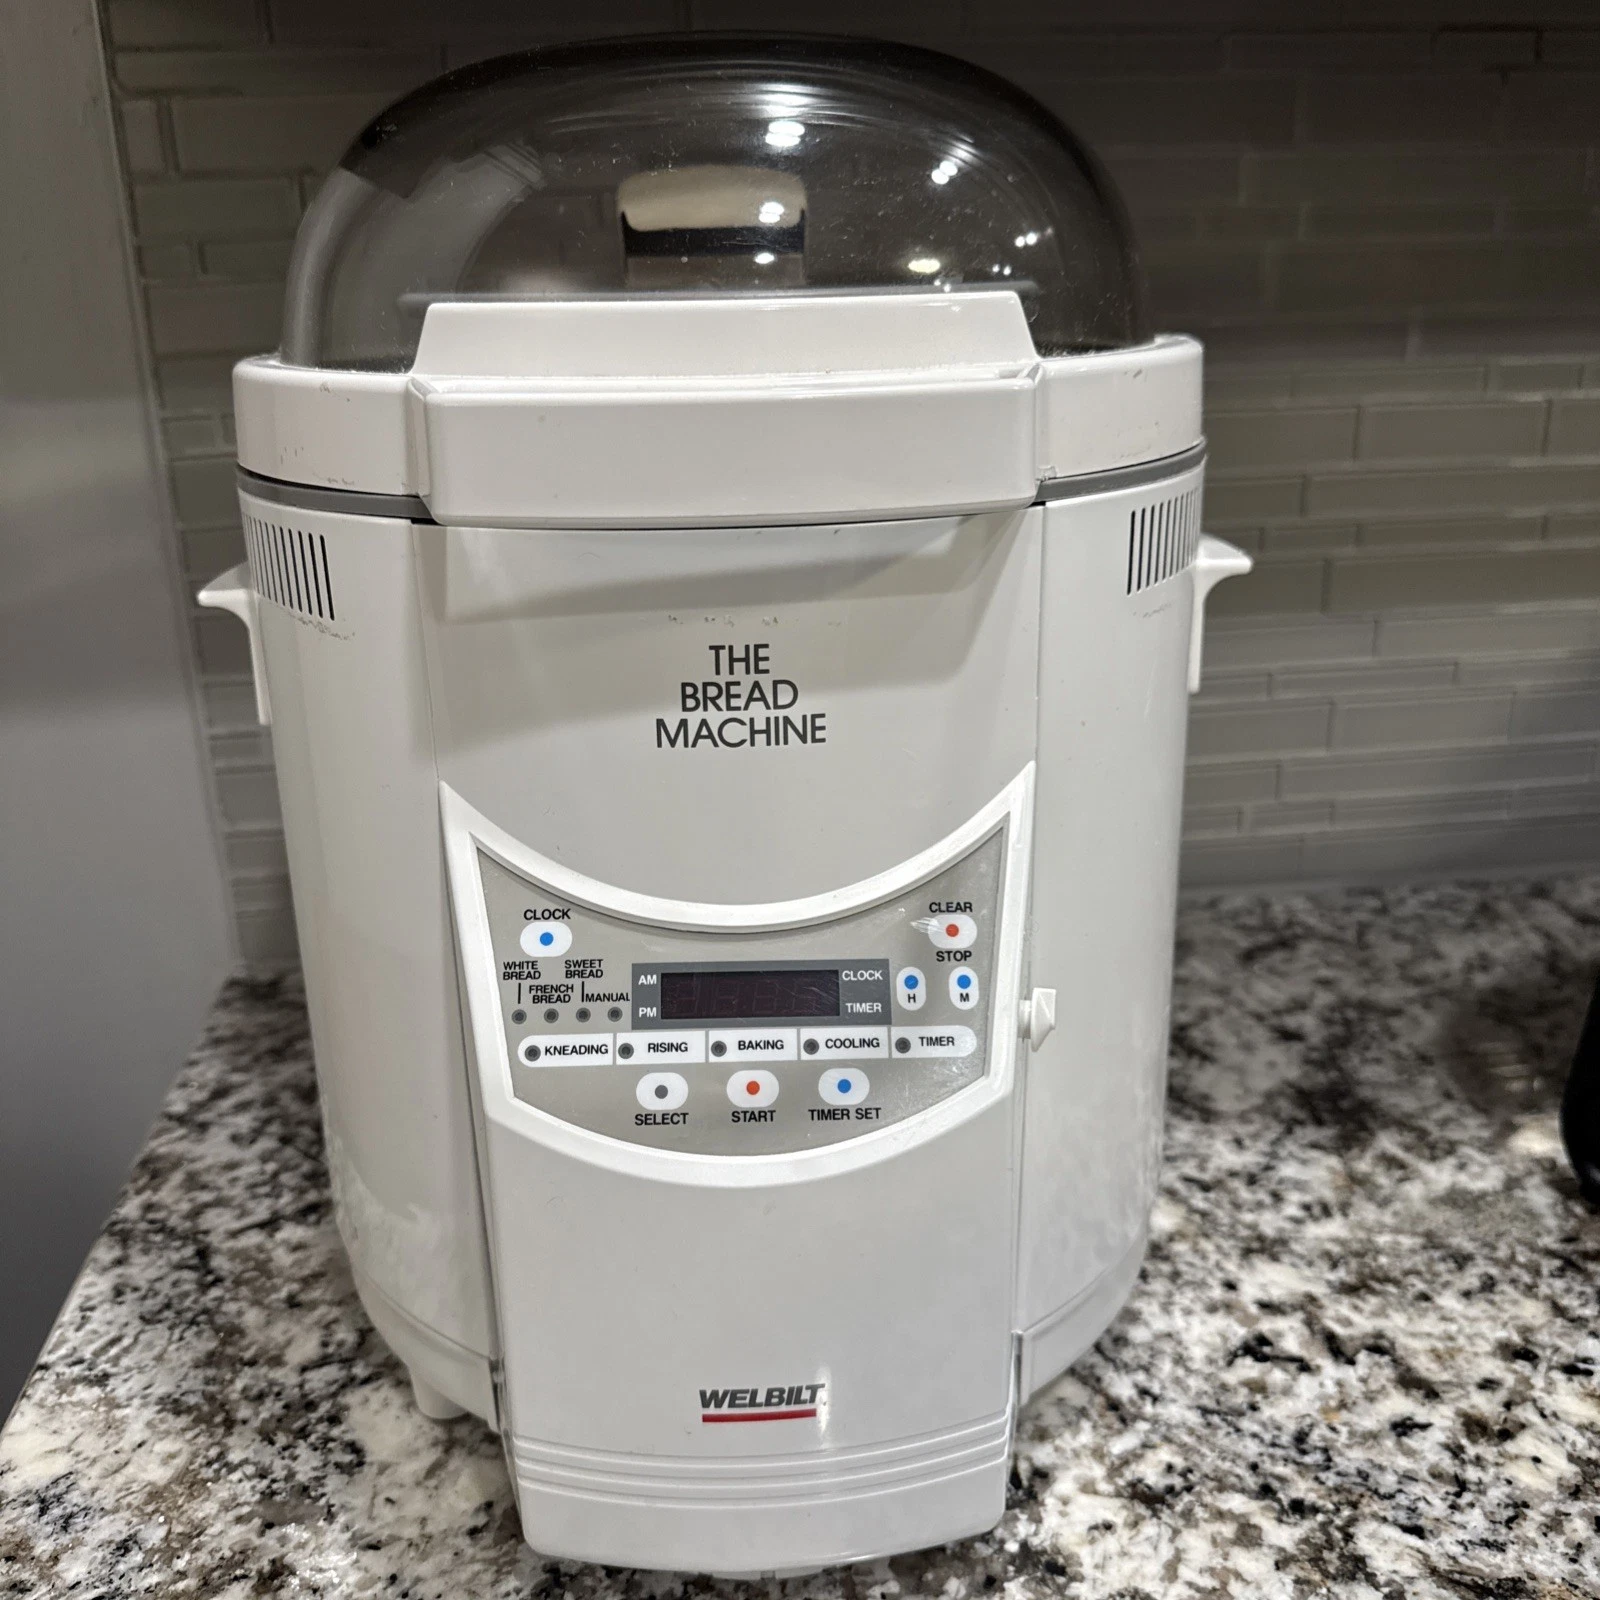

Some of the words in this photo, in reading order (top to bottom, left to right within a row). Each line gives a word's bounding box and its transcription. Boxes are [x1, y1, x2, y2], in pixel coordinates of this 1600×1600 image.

[709, 644, 770, 676] THE
[681, 679, 799, 712] BREAD
[656, 713, 827, 748] MACHINE
[929, 902, 973, 913] CLEAR
[523, 908, 571, 921] CLOCK
[936, 951, 972, 962] STOP
[503, 961, 539, 970] WHITE
[564, 959, 604, 969] SWEET
[503, 970, 541, 981] BREAD
[565, 969, 604, 979] BREAD
[842, 970, 883, 981] CLOCK
[638, 975, 657, 985] AM
[528, 984, 574, 994] FRENCH
[532, 994, 571, 1004] BREAD
[585, 992, 631, 1003] MANUAL
[908, 994, 916, 1003] H
[960, 993, 970, 1003] M
[638, 1007, 657, 1018] PM
[846, 1003, 882, 1014] TIMER
[738, 1039, 784, 1051] BAKING
[825, 1038, 880, 1049] COOLING
[918, 1036, 955, 1047] TIMER
[545, 1044, 609, 1056] KNEADING
[647, 1042, 688, 1053] RISING
[634, 1112, 689, 1126] SELECT
[731, 1109, 776, 1123] START
[808, 1108, 850, 1121] TIMER
[855, 1107, 882, 1120] SET
[699, 1383, 825, 1408] WELBILT
